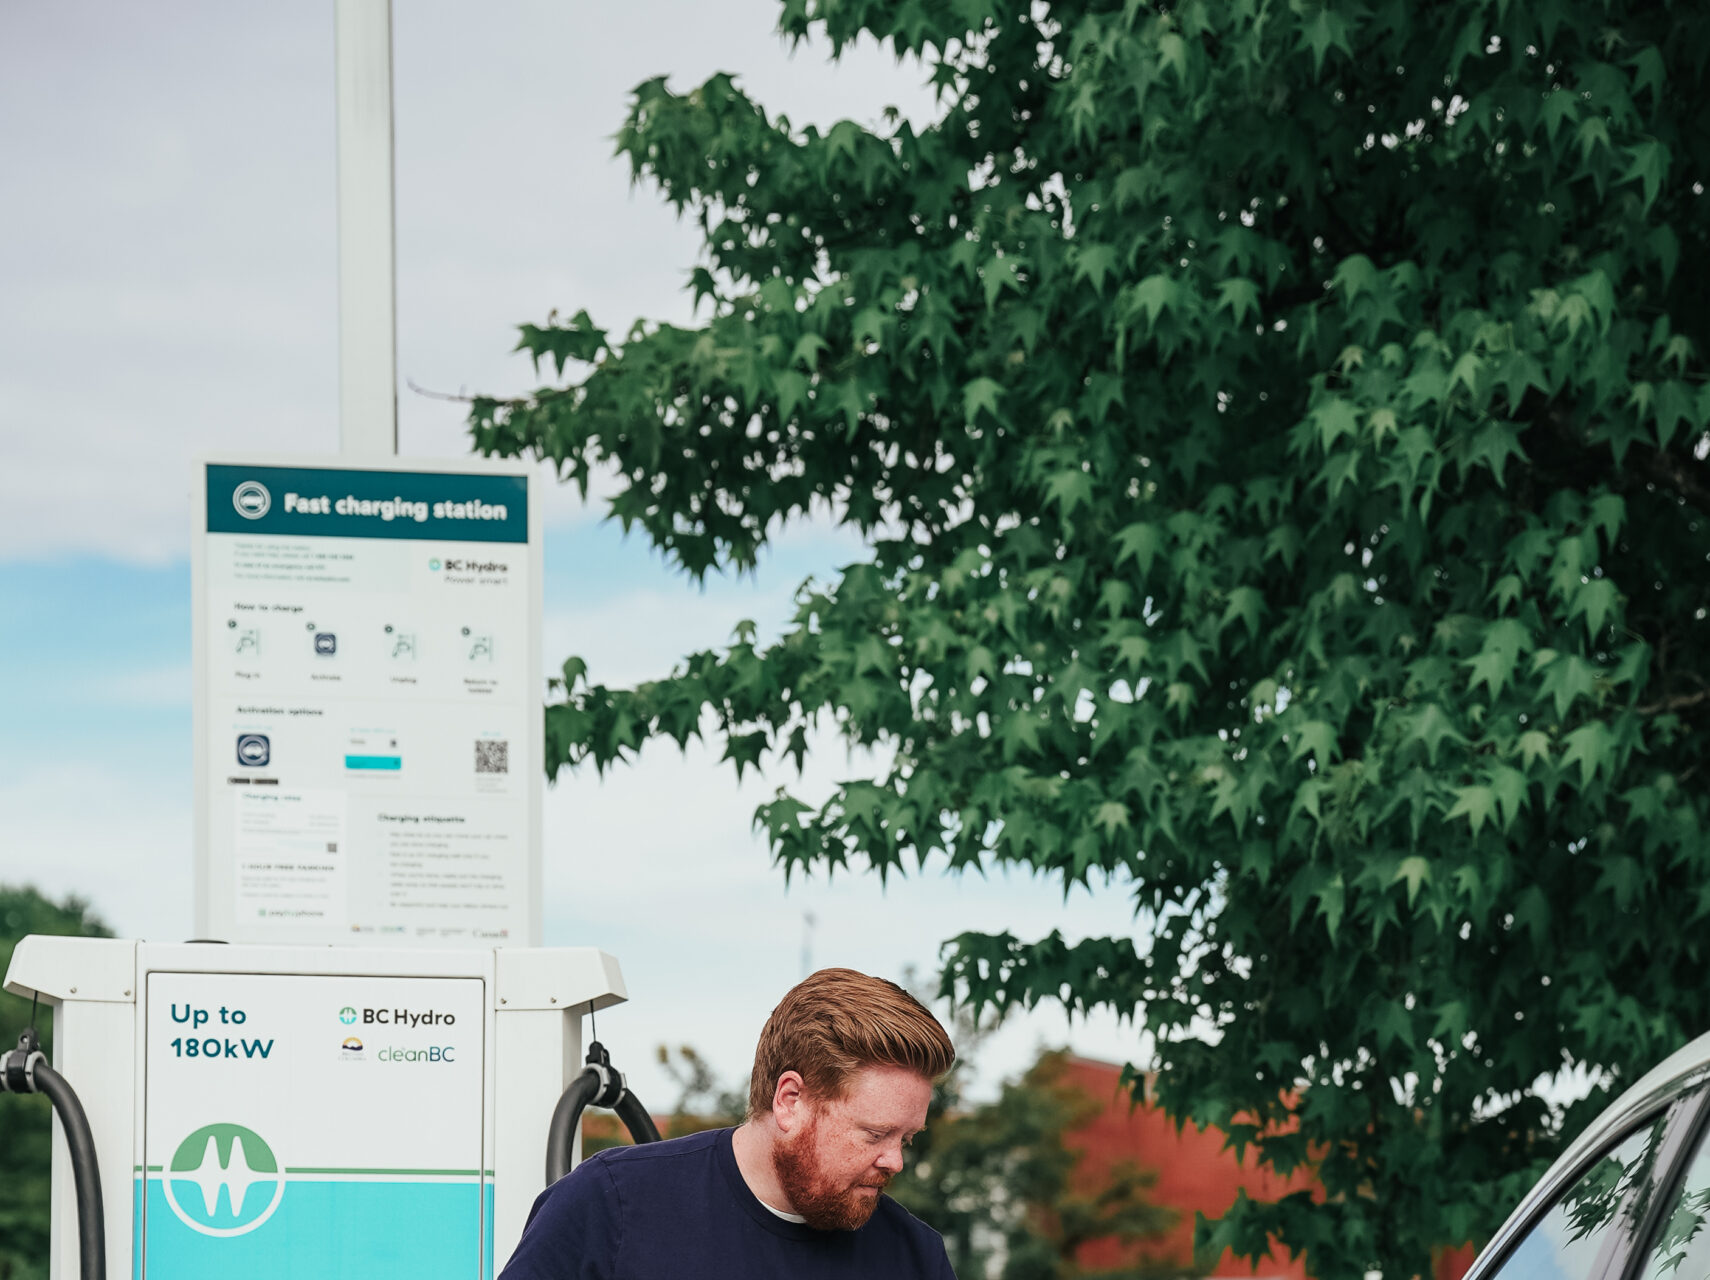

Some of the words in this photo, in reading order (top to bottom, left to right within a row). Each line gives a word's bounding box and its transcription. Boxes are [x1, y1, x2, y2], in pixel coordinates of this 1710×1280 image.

[284, 492, 331, 515] Fast
[335, 496, 429, 523] charging
[433, 498, 508, 521] station
[445, 559, 462, 572] BC
[466, 560, 508, 574] Hydro
[170, 1003, 210, 1029] Up
[219, 1006, 247, 1025] to
[362, 1008, 390, 1025] BC
[393, 1009, 457, 1029] Hydro
[170, 1038, 275, 1059] 180kW
[377, 1045, 457, 1063] cleanBC
